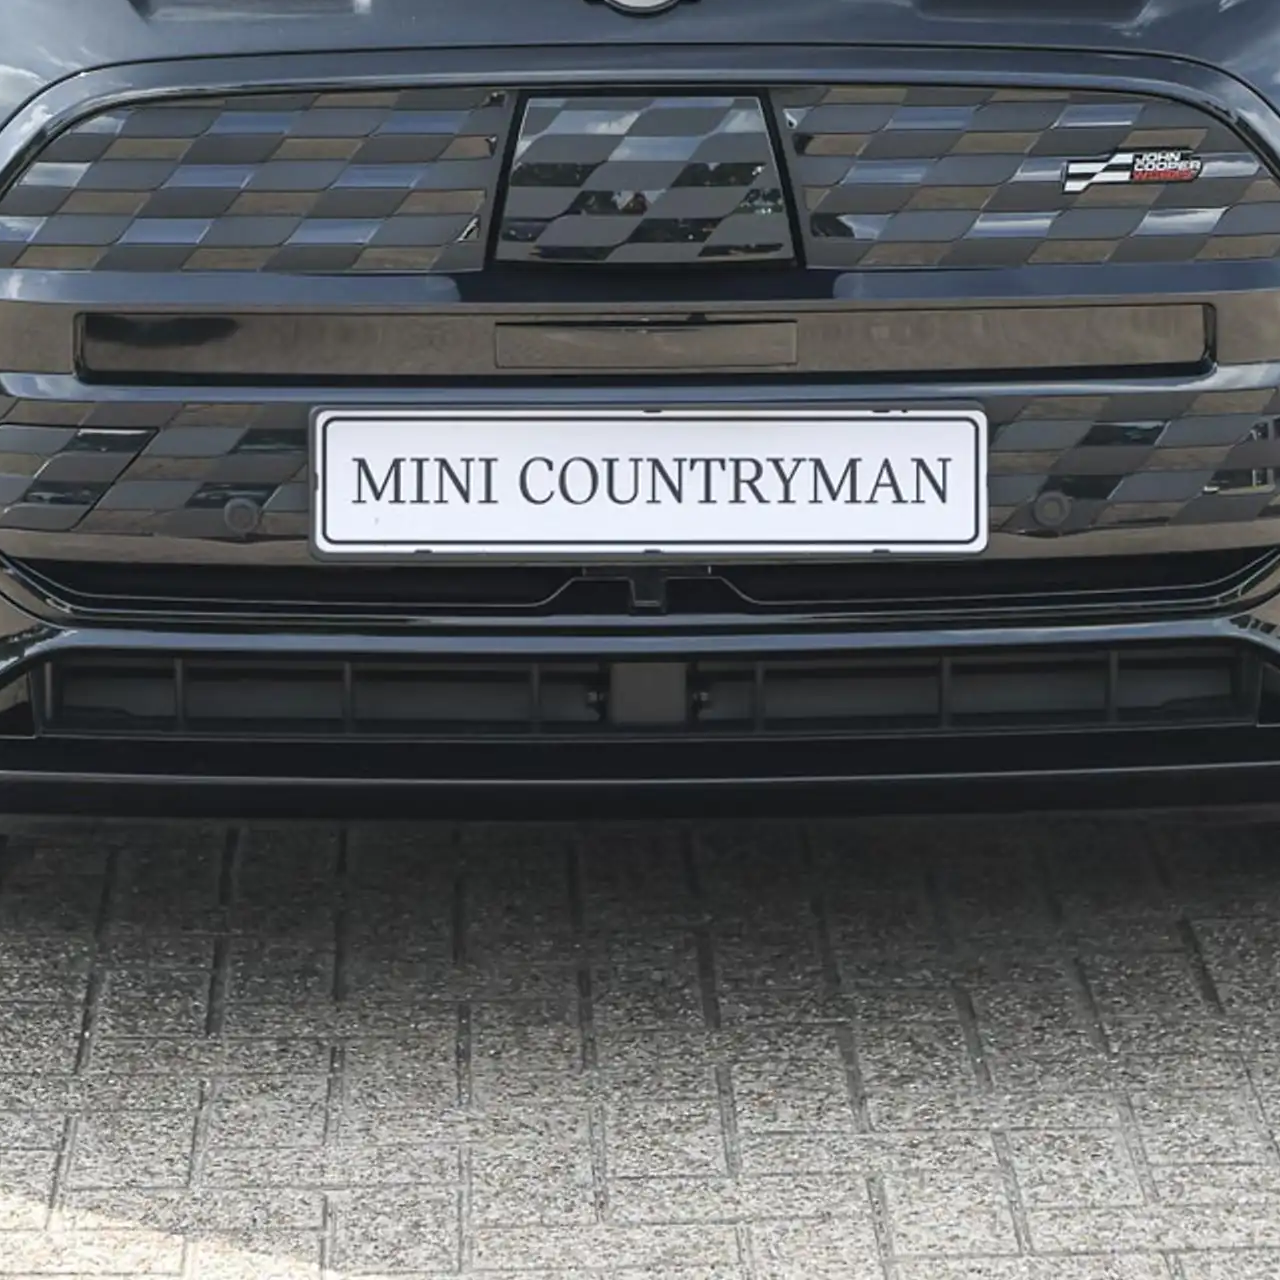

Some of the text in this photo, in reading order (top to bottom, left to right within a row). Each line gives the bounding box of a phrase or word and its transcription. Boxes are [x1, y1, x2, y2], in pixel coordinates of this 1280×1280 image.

[1135, 151, 1182, 161] JOHN
[1134, 160, 1202, 171] COOPER
[352, 456, 952, 505] MINI COUNTRYMAN
